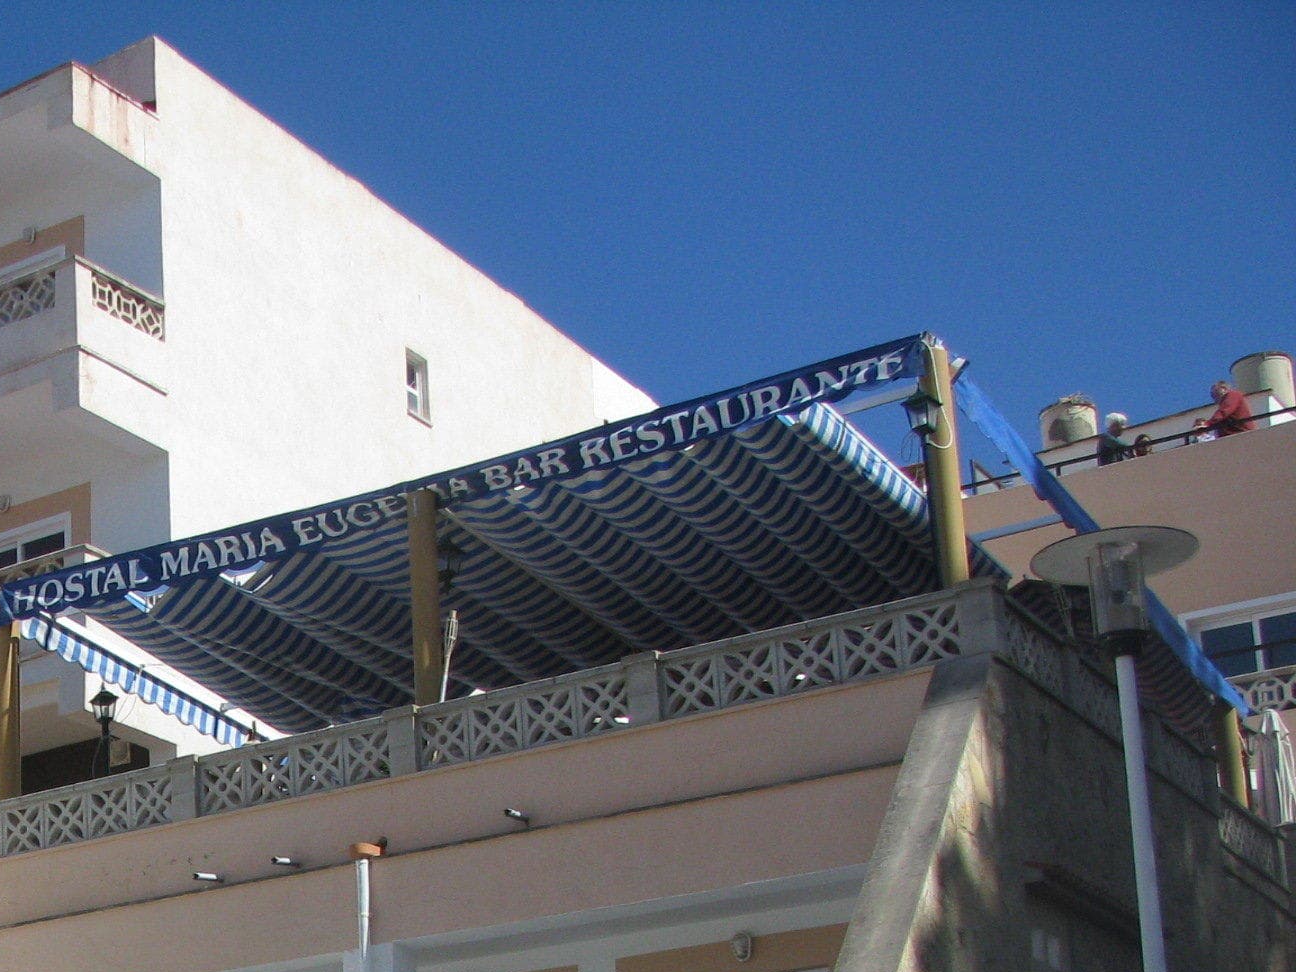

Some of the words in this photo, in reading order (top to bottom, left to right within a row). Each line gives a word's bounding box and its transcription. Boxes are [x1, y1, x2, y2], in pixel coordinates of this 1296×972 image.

[12, 558, 150, 614] HOSTAL
[160, 527, 287, 581] MARIA
[292, 477, 477, 546] EUGEIA
[479, 446, 569, 491] BAR
[578, 350, 906, 469] RESTAURANTE
